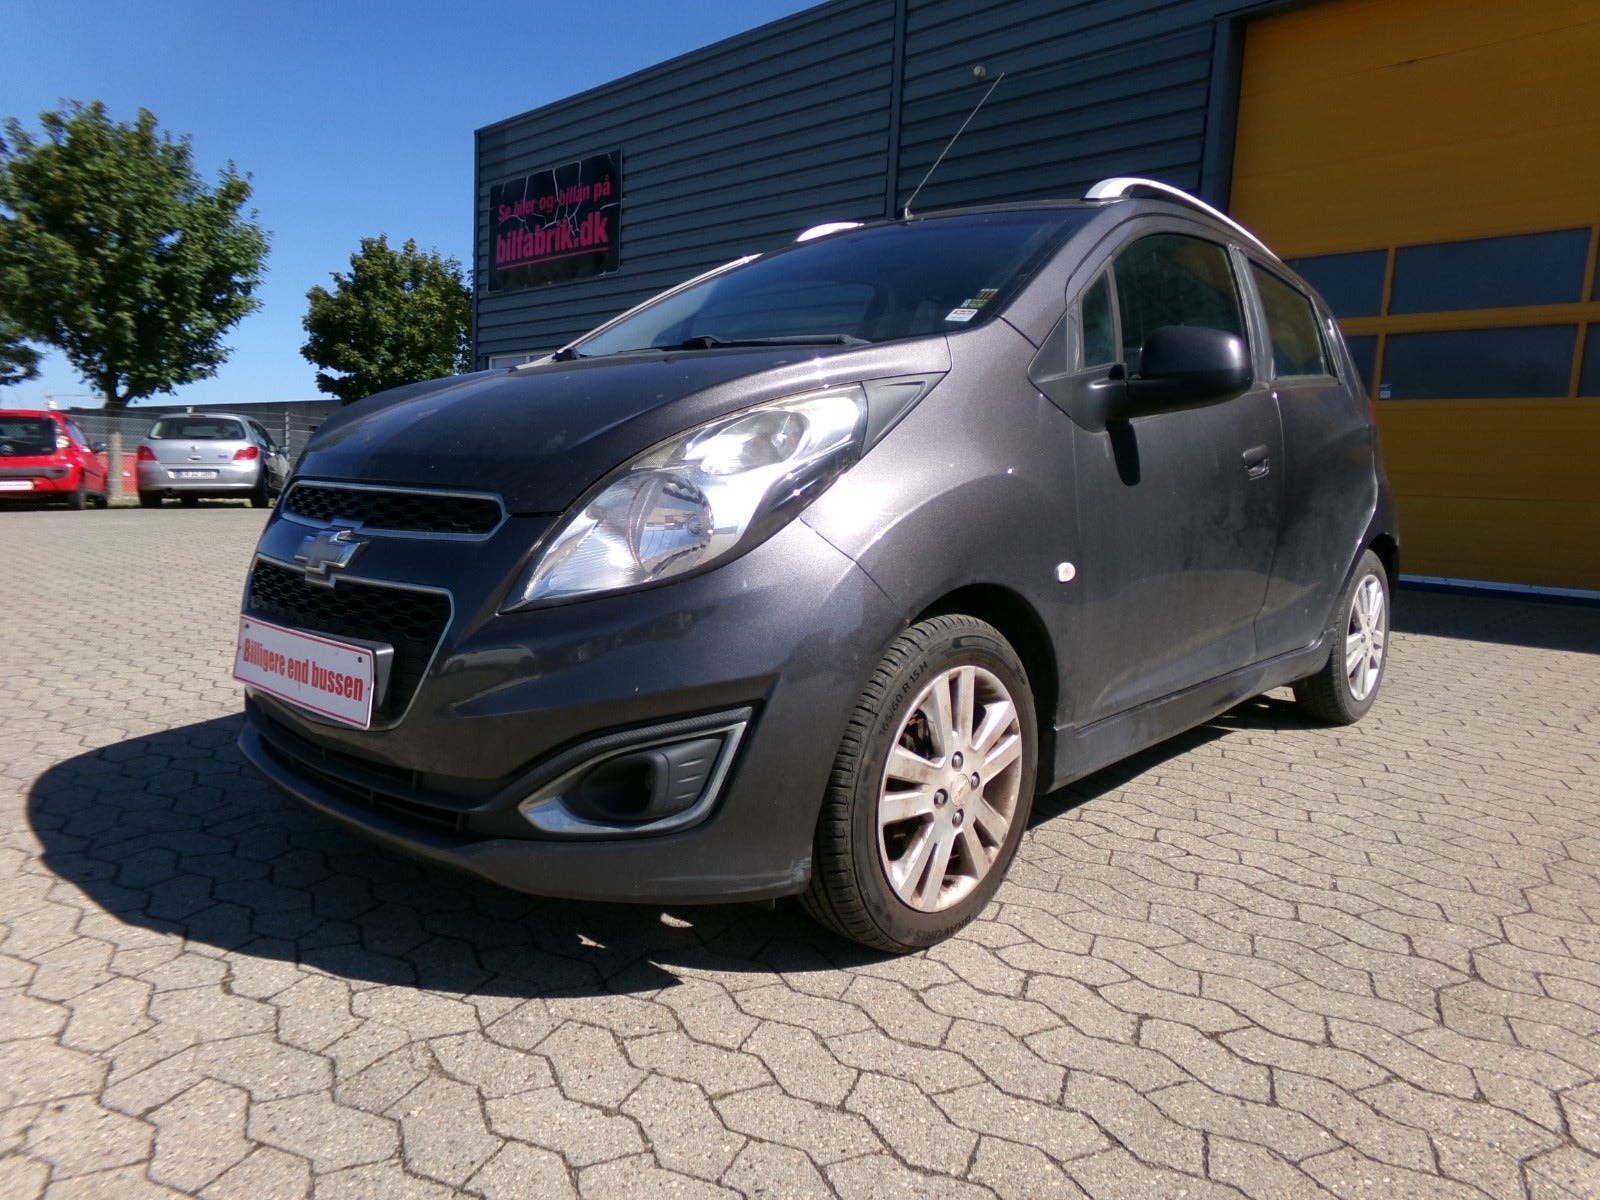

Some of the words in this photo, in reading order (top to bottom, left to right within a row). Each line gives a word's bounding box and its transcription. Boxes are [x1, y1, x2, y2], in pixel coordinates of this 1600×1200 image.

[498, 204, 510, 222] Se
[514, 199, 536, 215] biler
[539, 196, 555, 211] og
[594, 175, 611, 200] på
[496, 212, 609, 263] bilfabrik.dk
[243, 638, 285, 676] Billigere
[287, 657, 309, 684] end
[311, 661, 364, 702] bussen
[878, 694, 904, 736] 165/60
[902, 682, 911, 694] R
[909, 671, 920, 683] 15
[919, 661, 929, 674] H
